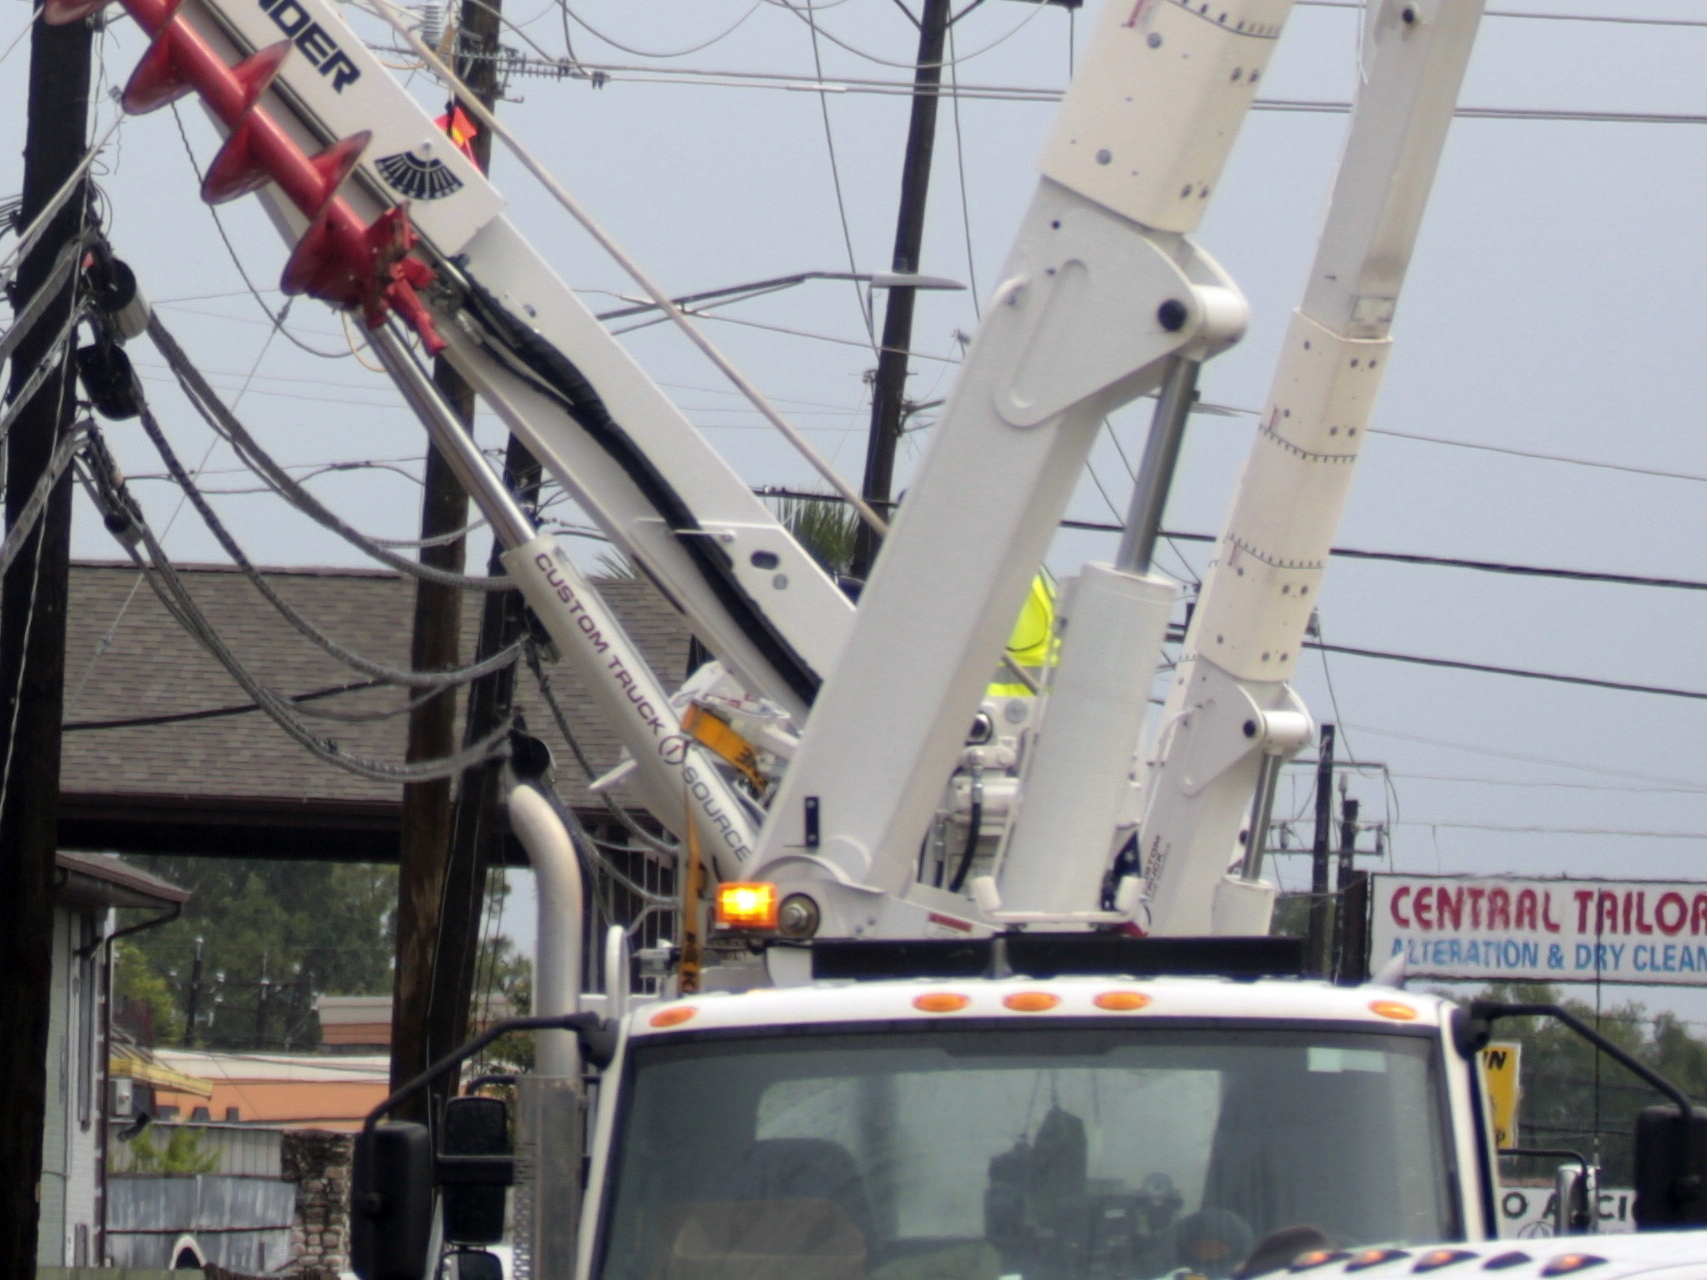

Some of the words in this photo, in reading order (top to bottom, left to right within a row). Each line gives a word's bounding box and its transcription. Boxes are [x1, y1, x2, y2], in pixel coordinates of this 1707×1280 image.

[533, 552, 610, 655] CUSTOM
[607, 655, 666, 737] TRUCK
[681, 765, 752, 864] SOURCE
[1390, 885, 1561, 934] CENTRAL
[1390, 938, 1538, 969] ALTERATION
[1547, 942, 1565, 970] &
[1574, 943, 1626, 971] DRY
